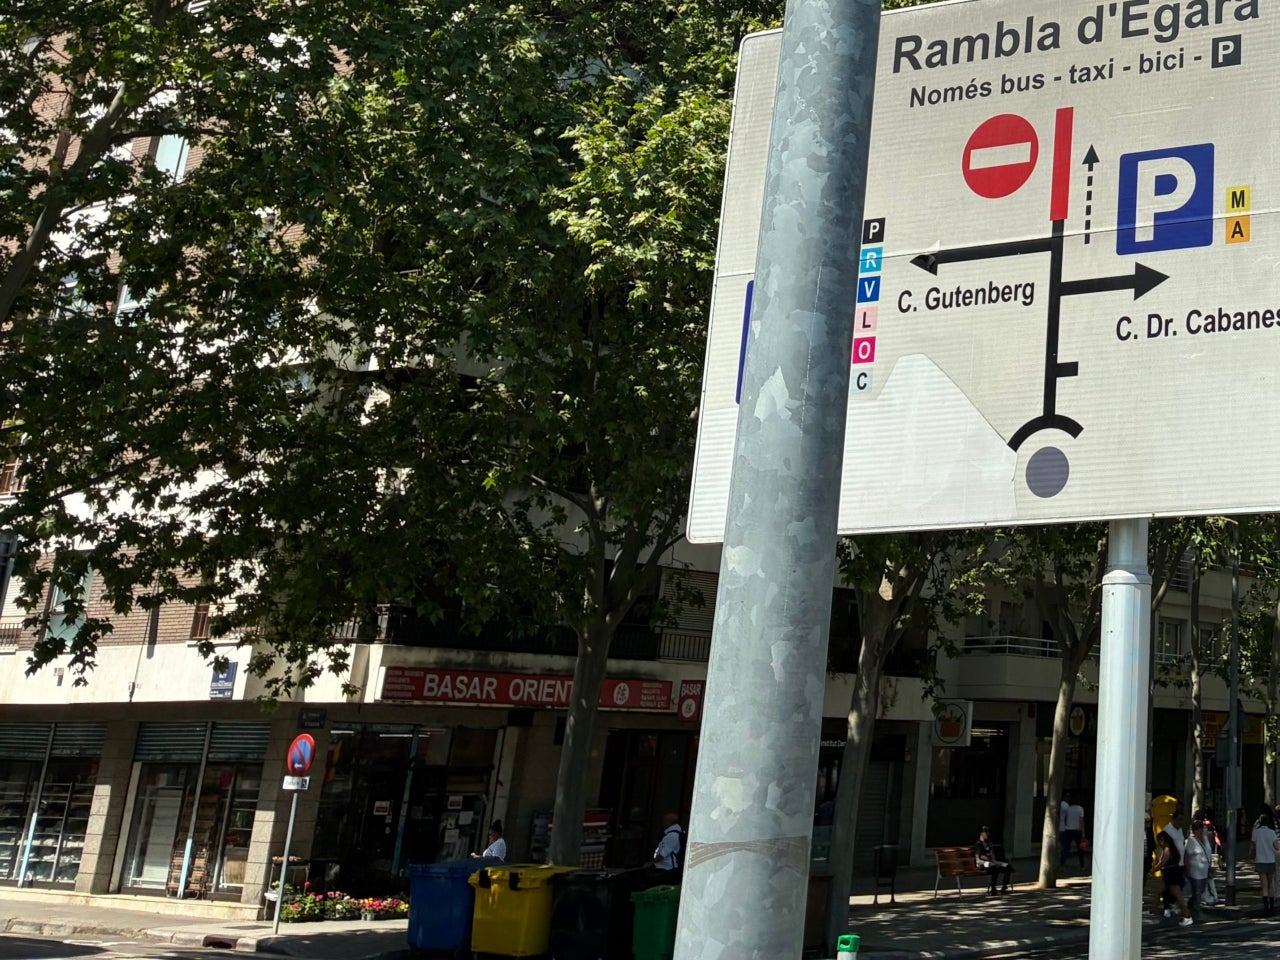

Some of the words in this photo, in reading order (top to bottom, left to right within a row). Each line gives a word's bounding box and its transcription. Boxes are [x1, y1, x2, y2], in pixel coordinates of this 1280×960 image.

[893, 16, 1060, 73] Rambla
[910, 78, 991, 107] Només
[1001, 74, 1044, 94] bus
[1069, 58, 1113, 84] taxi
[1139, 48, 1184, 74] bici
[1219, 41, 1234, 63] P
[1135, 157, 1196, 242] P
[1232, 190, 1244, 208] M
[869, 222, 879, 239] P
[1231, 221, 1244, 238] A
[866, 252, 877, 268] R
[865, 281, 875, 297] V
[898, 290, 917, 313] C.
[926, 281, 1034, 310] Gutenberg
[863, 312, 871, 328] L
[1117, 316, 1137, 341] C.
[1147, 314, 1176, 338] Dr.
[859, 342, 870, 359] O
[857, 372, 867, 390] C
[423, 674, 498, 700] BASAR
[508, 679, 574, 703] ORIENT
